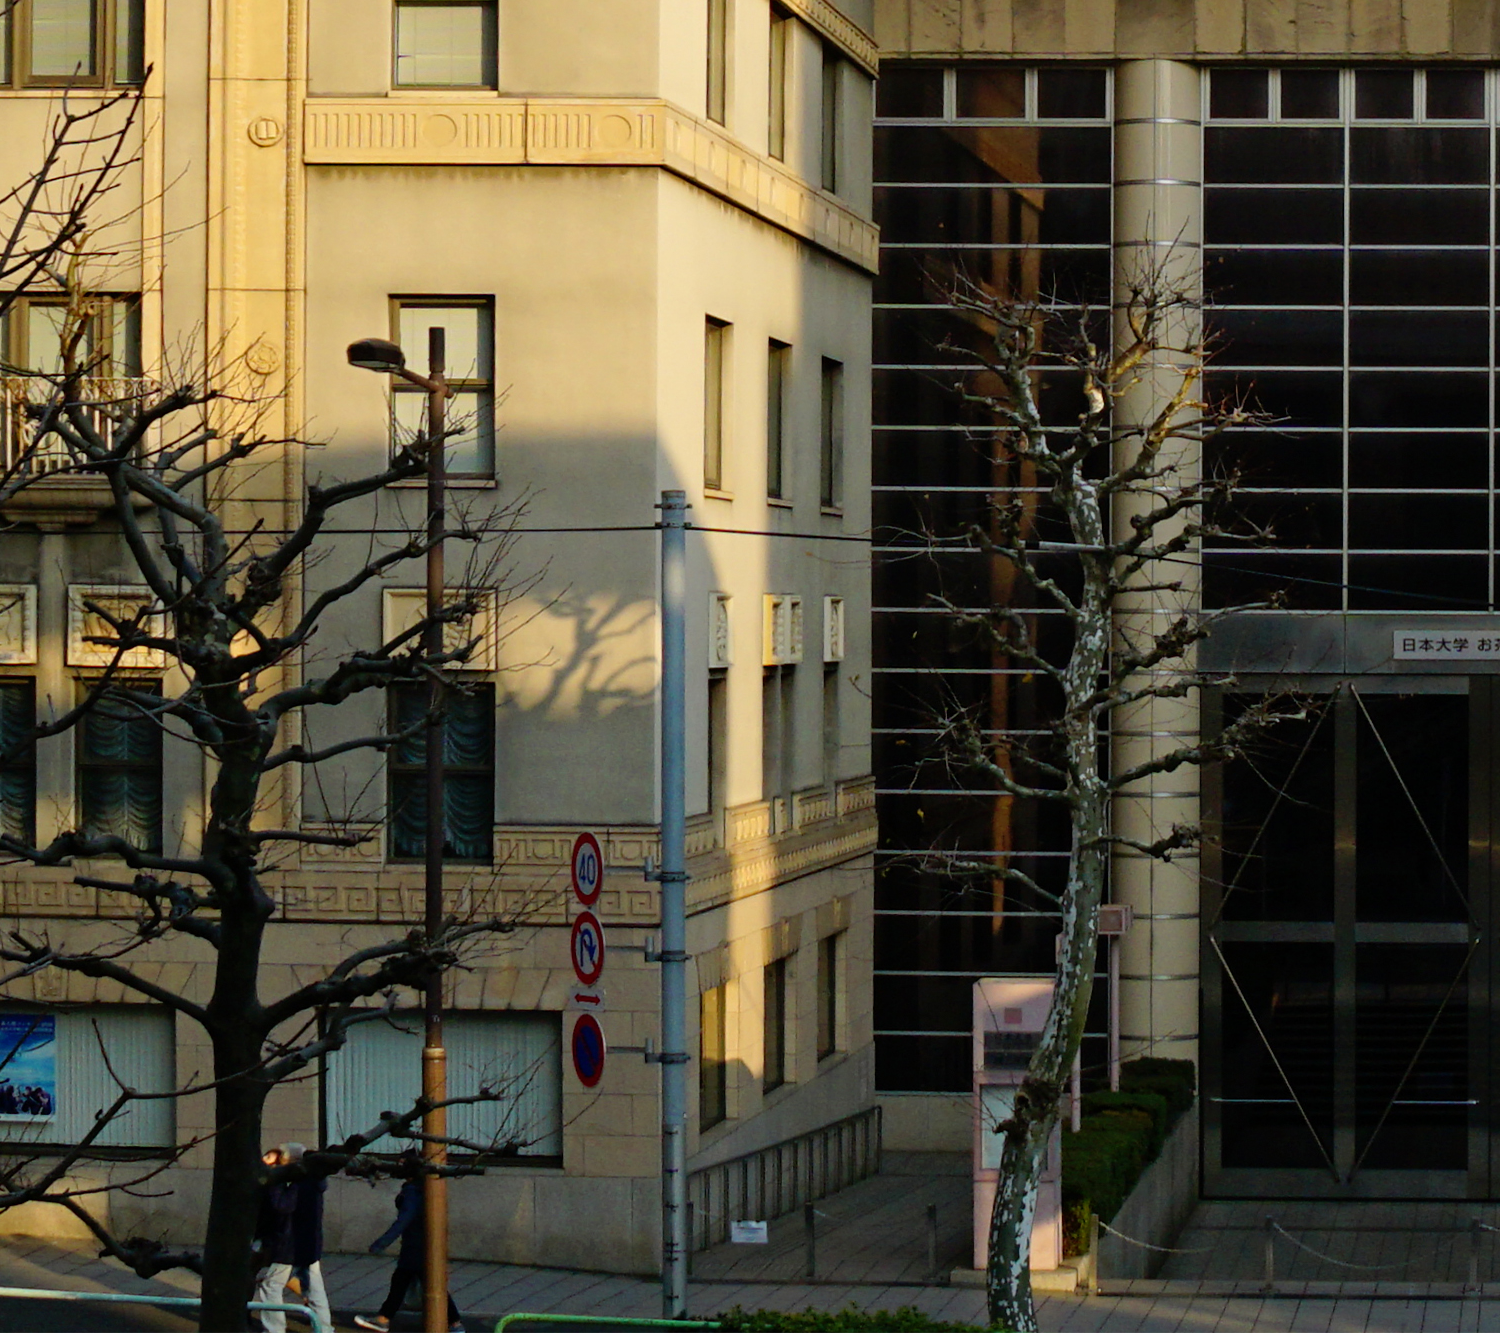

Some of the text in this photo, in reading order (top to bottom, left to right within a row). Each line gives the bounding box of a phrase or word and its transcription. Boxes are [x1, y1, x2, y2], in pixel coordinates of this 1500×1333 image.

[1402, 637, 1469, 652] 日本大学
[579, 853, 596, 885] 40
